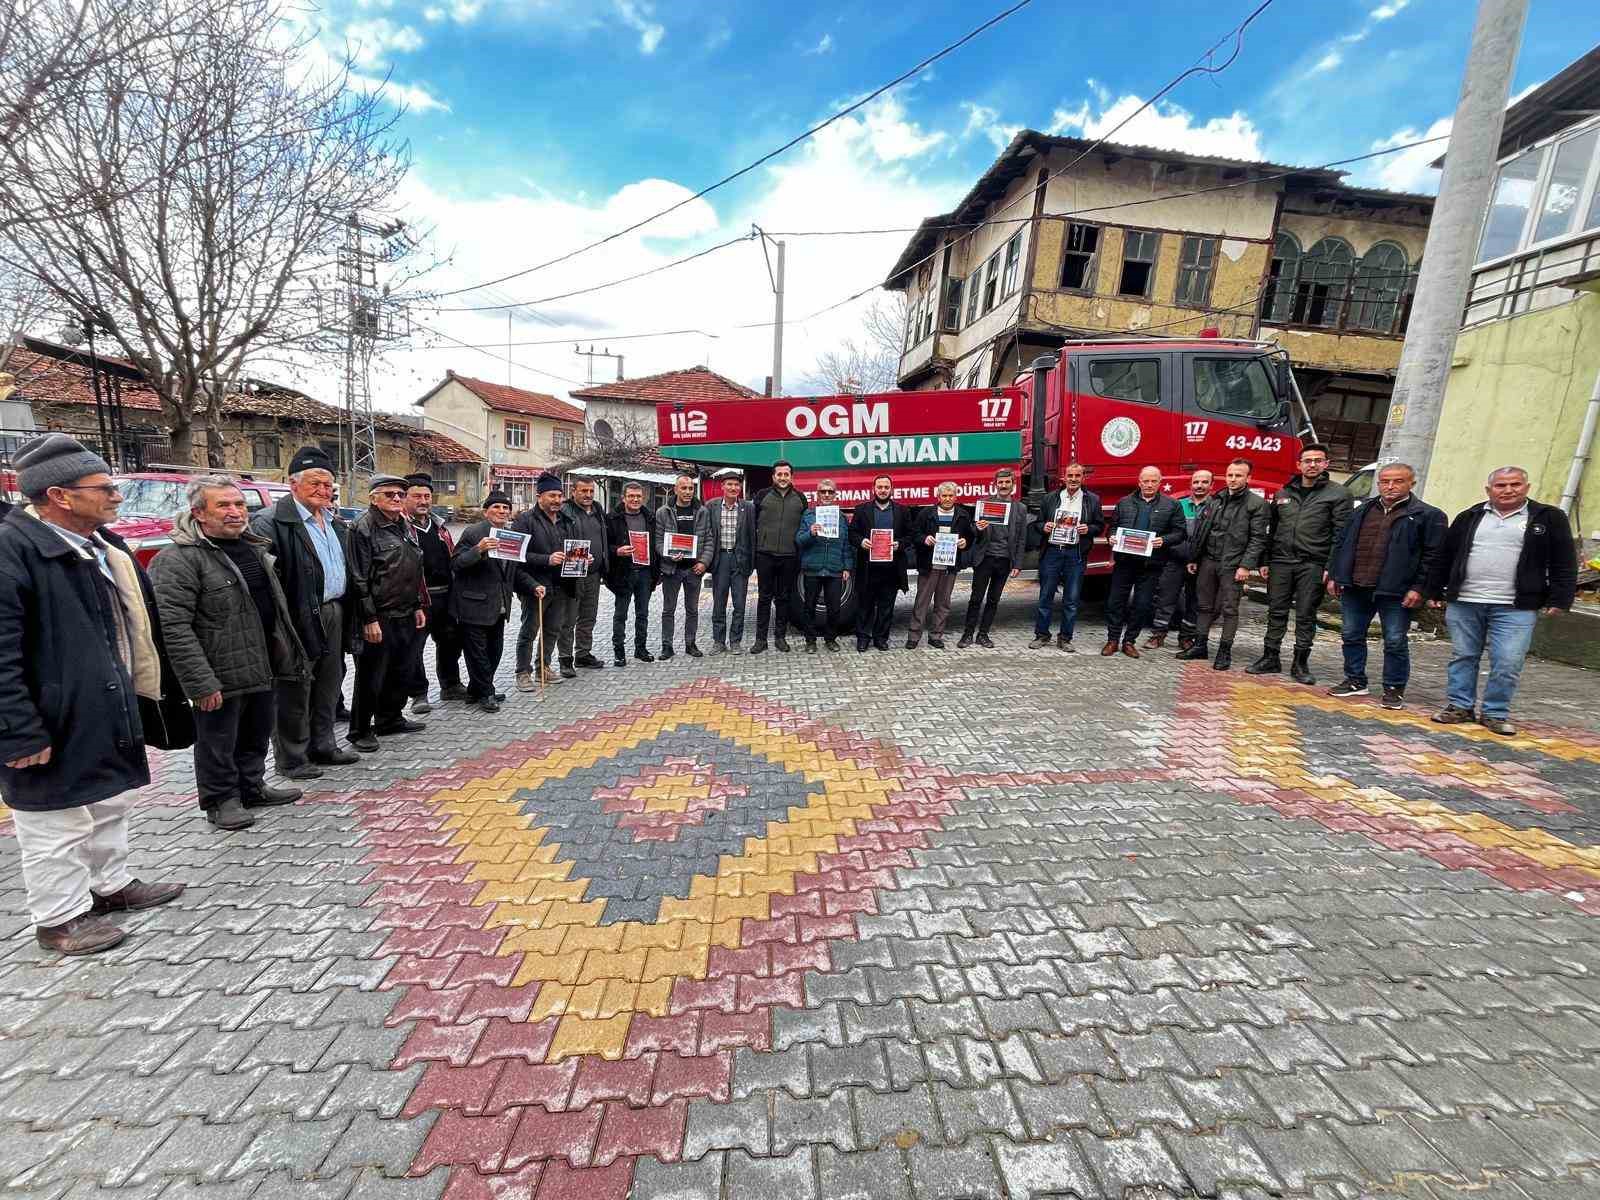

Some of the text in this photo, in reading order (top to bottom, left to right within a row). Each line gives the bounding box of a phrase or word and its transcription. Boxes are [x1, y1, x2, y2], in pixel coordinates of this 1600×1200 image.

[978, 398, 1012, 417] 177
[670, 410, 708, 431] 112
[785, 402, 890, 437] OGM
[1184, 421, 1209, 435] 177
[843, 436, 960, 465] ORMAN
[1225, 435, 1282, 452] 43-A23
[834, 488, 871, 501] RMAN
